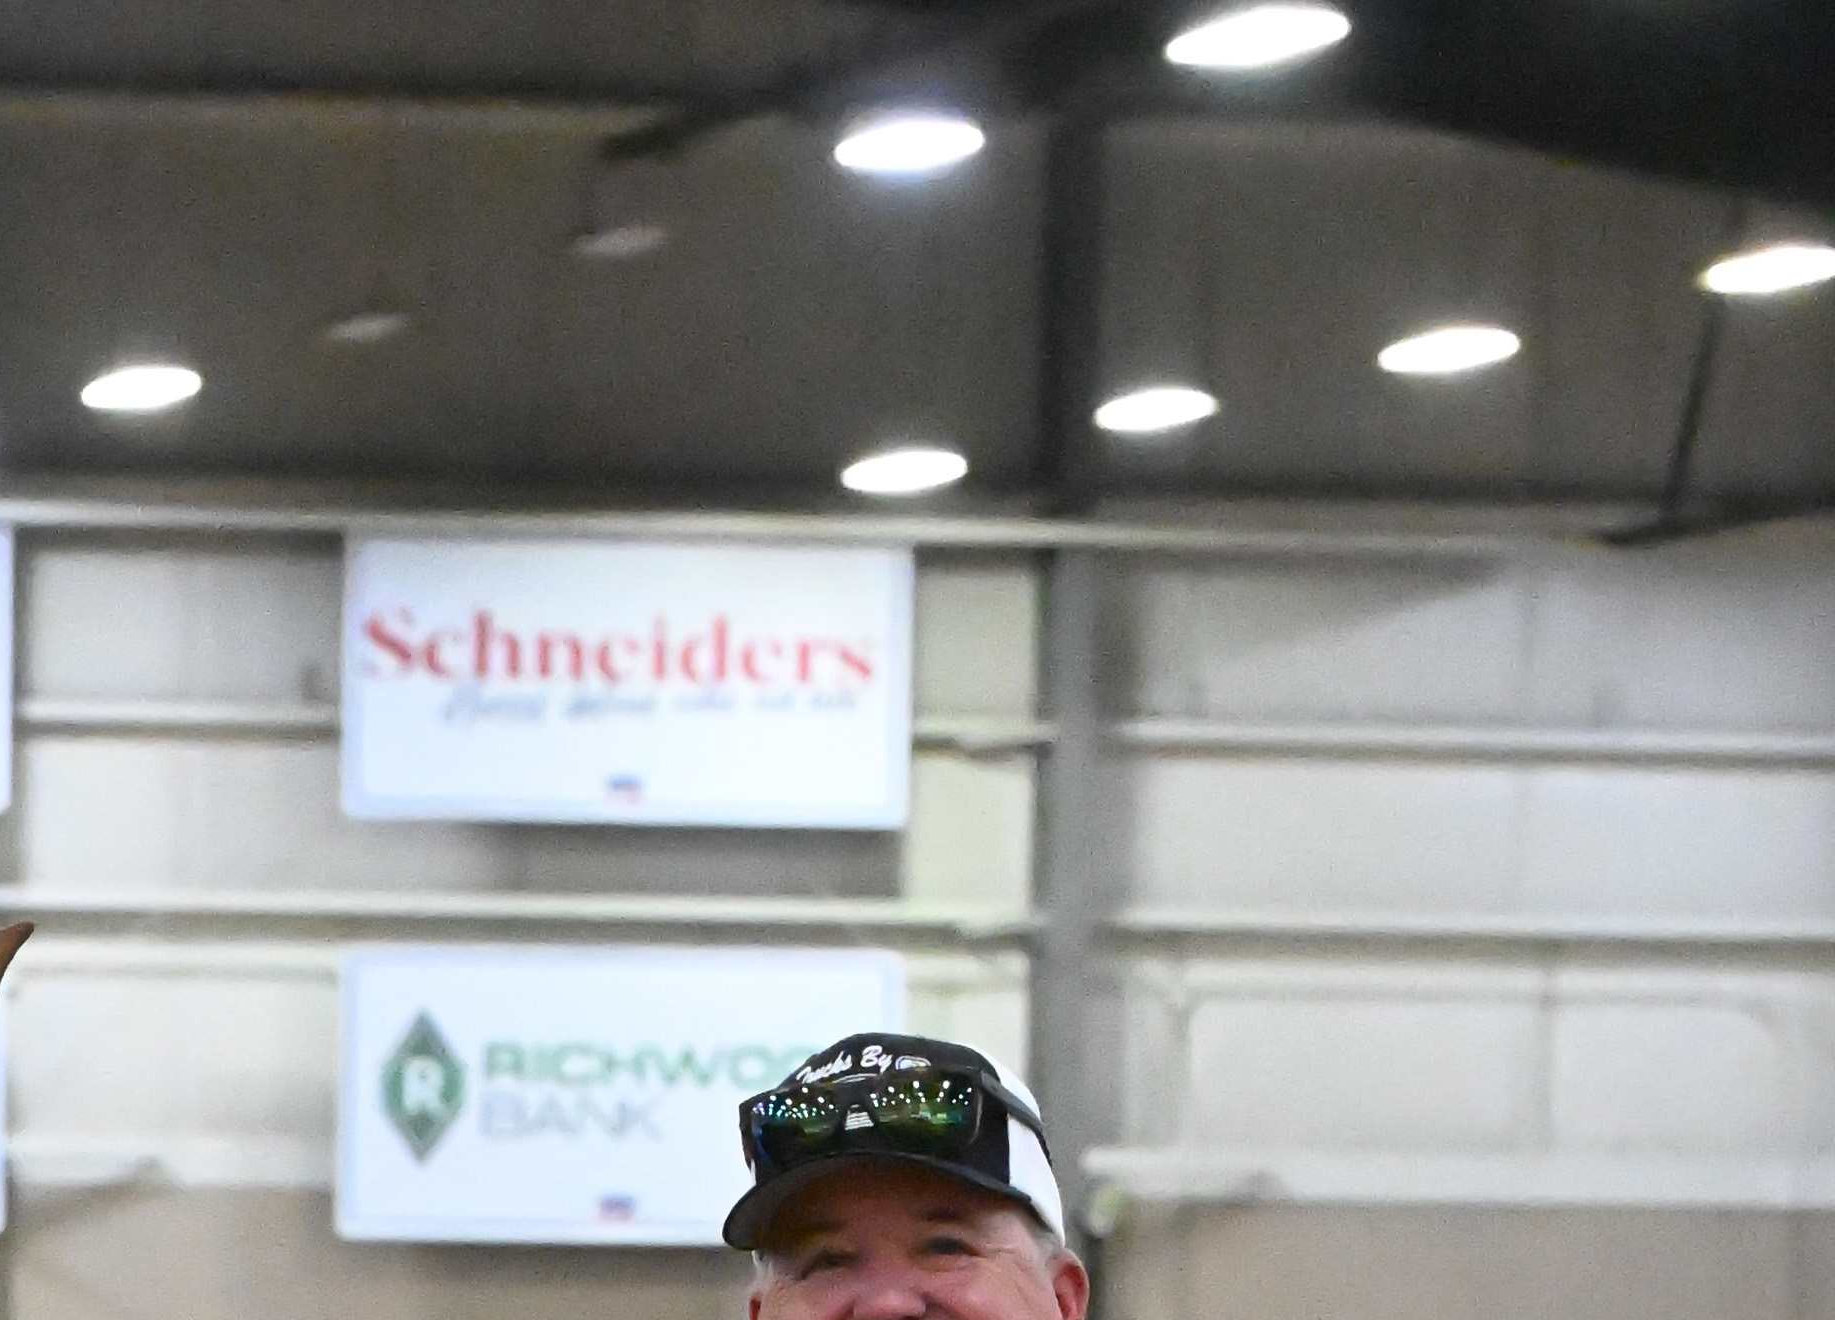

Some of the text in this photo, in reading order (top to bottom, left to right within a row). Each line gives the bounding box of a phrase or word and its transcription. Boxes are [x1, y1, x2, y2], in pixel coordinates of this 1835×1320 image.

[363, 609, 874, 682] Schneiders
[485, 1041, 825, 1090] RICHWO
[860, 1045, 893, 1074] By
[479, 1091, 663, 1140] BANK
